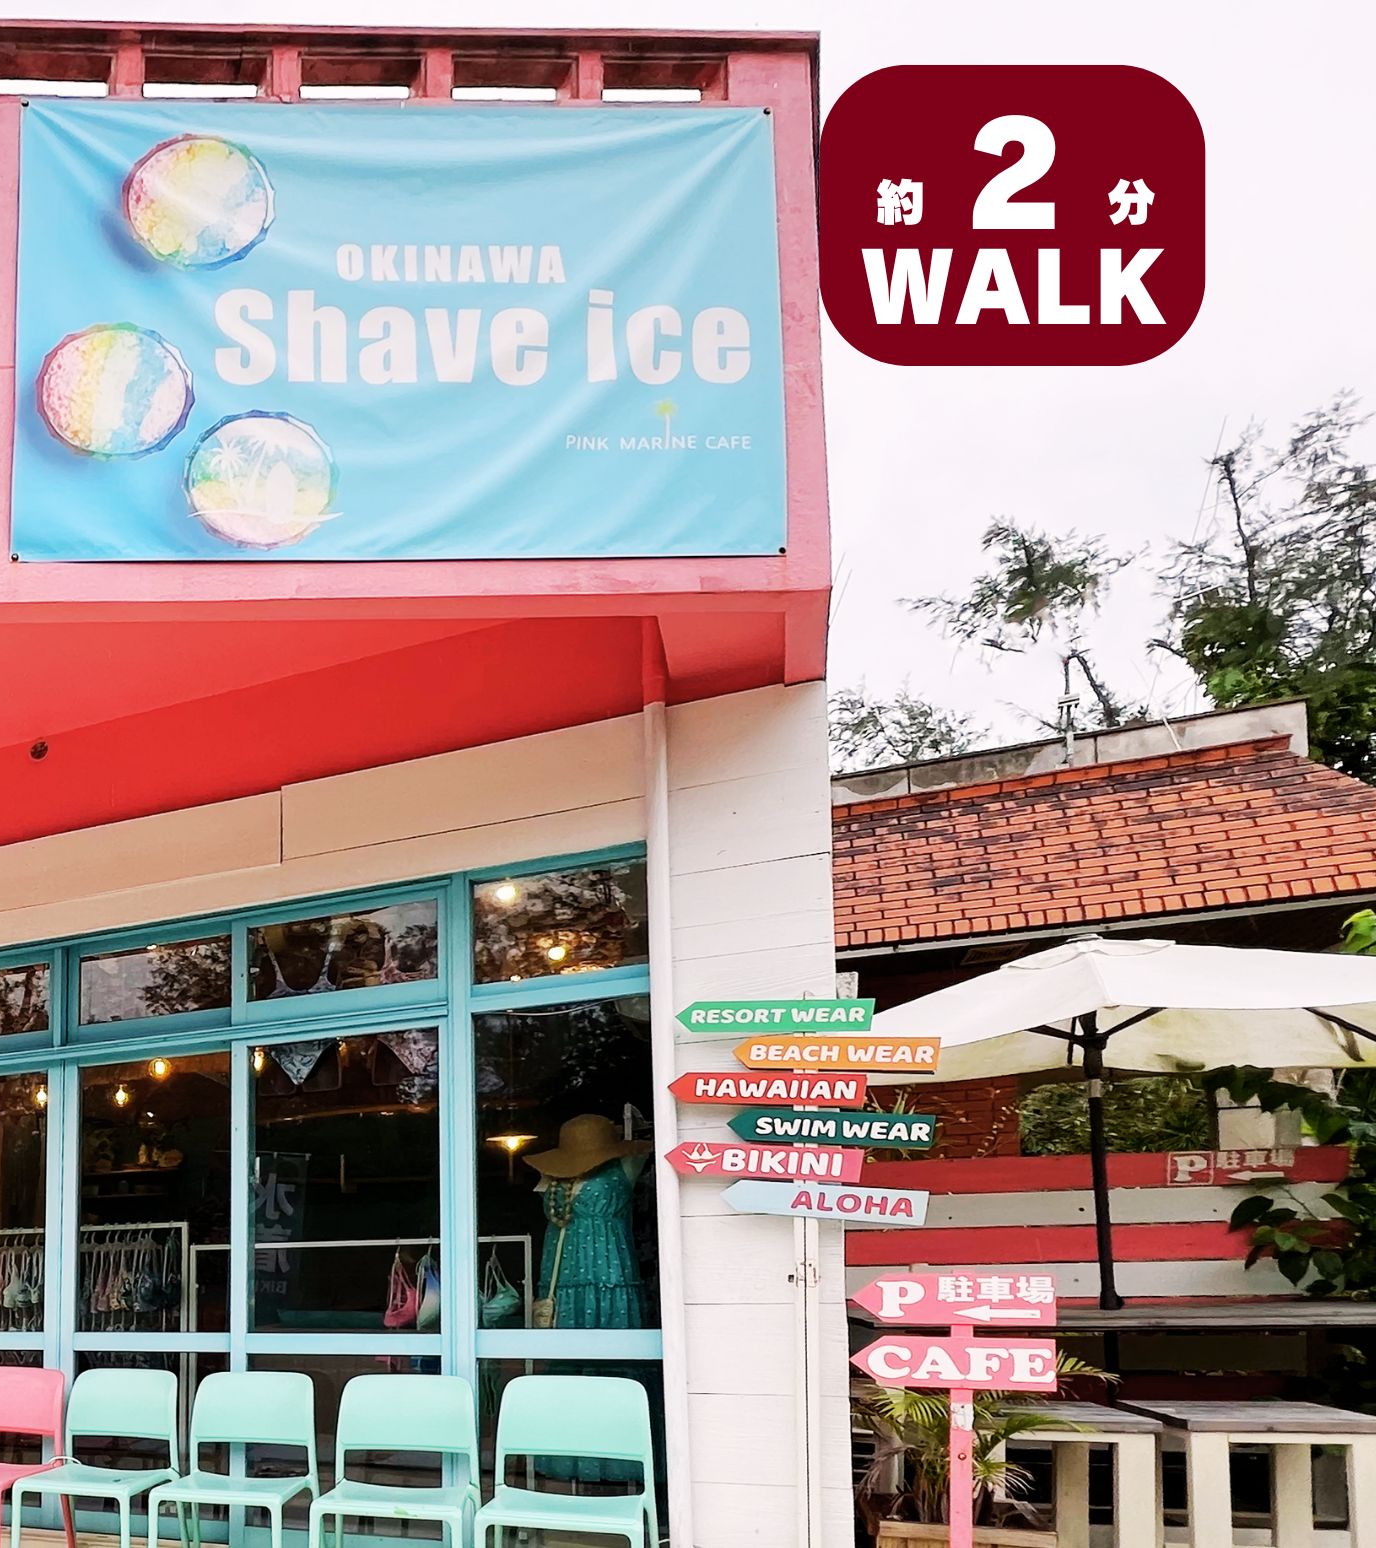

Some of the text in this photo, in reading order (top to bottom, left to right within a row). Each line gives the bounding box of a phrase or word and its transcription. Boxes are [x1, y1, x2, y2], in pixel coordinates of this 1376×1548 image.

[336, 243, 566, 285] OKINAWA
[214, 289, 752, 386] Shave ice
[566, 424, 753, 451] PINK MARINE CAFE
[690, 1007, 866, 1024] RESORT WEAR
[749, 1045, 935, 1064] BEACH WEAR
[695, 1078, 857, 1100] HAWAIIAN
[755, 1117, 931, 1142] SWIM WEAR
[721, 1148, 844, 1177] BIKINI
[1172, 1155, 1208, 1182] P
[791, 1190, 914, 1218] ALOHA
[876, 1276, 1055, 1318] P 駐車場
[867, 1345, 1055, 1383] CAFE
